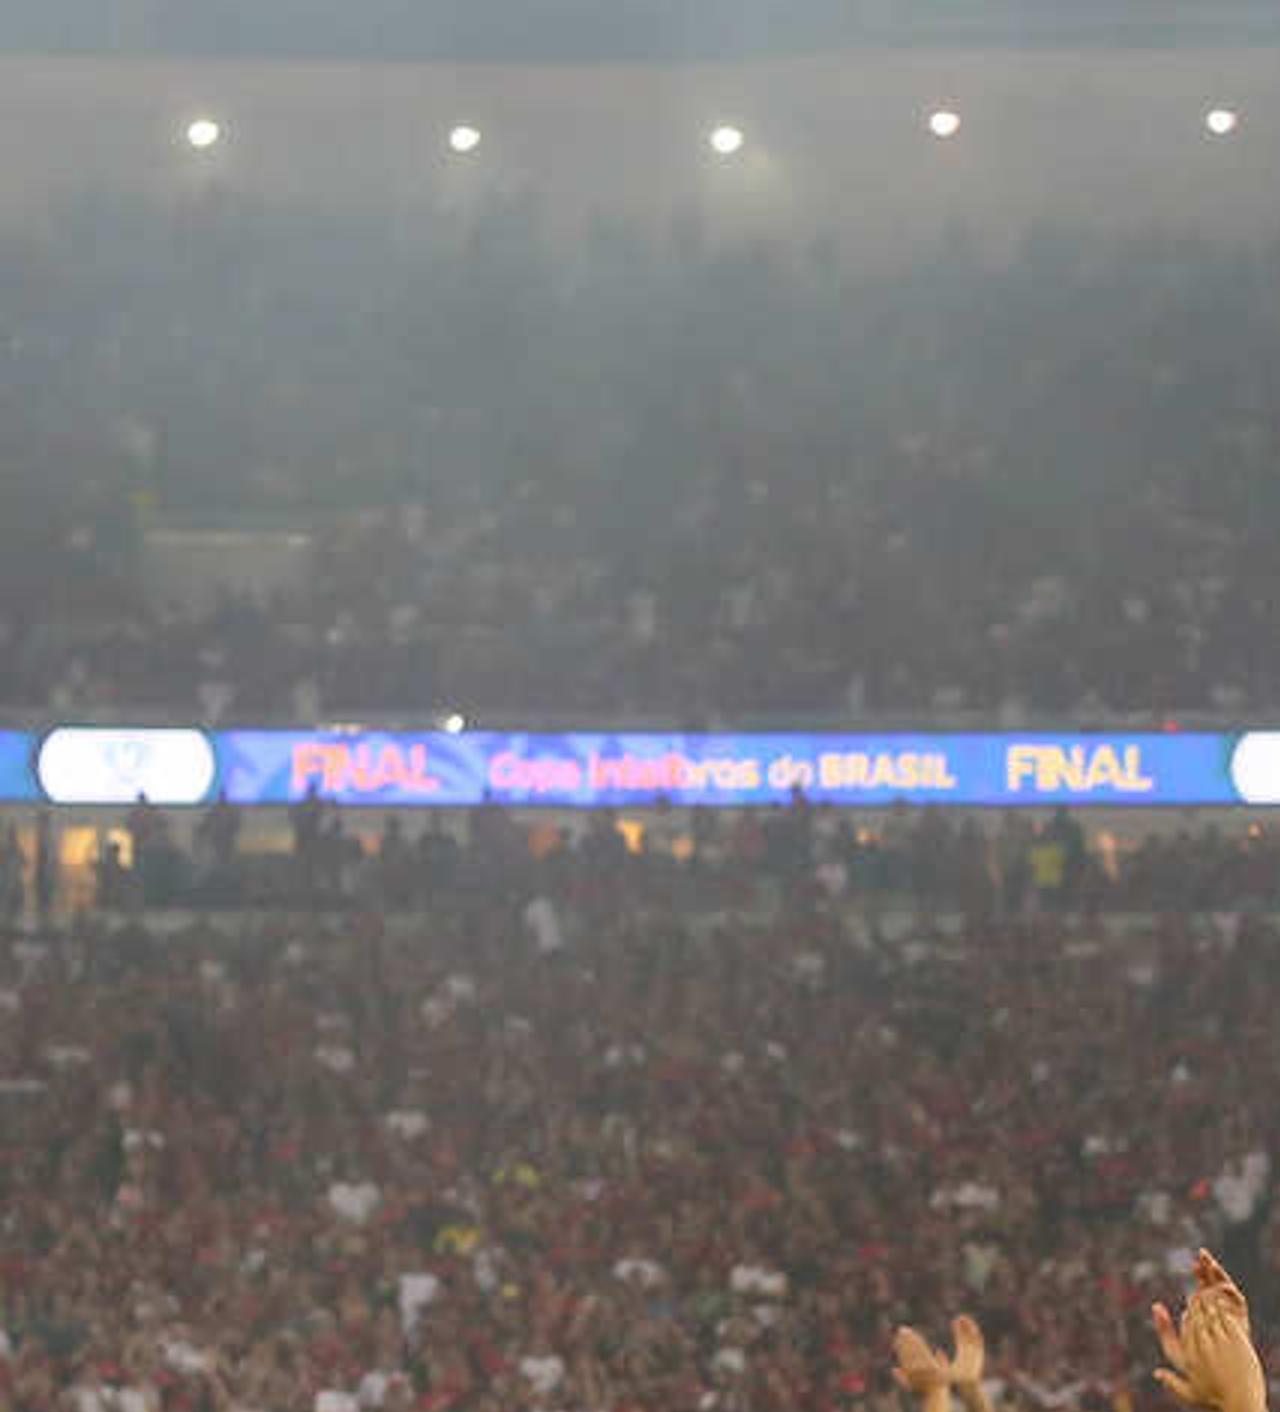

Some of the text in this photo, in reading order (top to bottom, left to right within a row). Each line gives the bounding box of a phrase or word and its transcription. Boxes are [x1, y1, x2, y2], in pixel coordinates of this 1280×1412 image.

[291, 742, 440, 791] FINAL
[768, 753, 813, 788] do
[819, 752, 955, 789] BRASIL
[1007, 743, 1154, 791] FINAL
